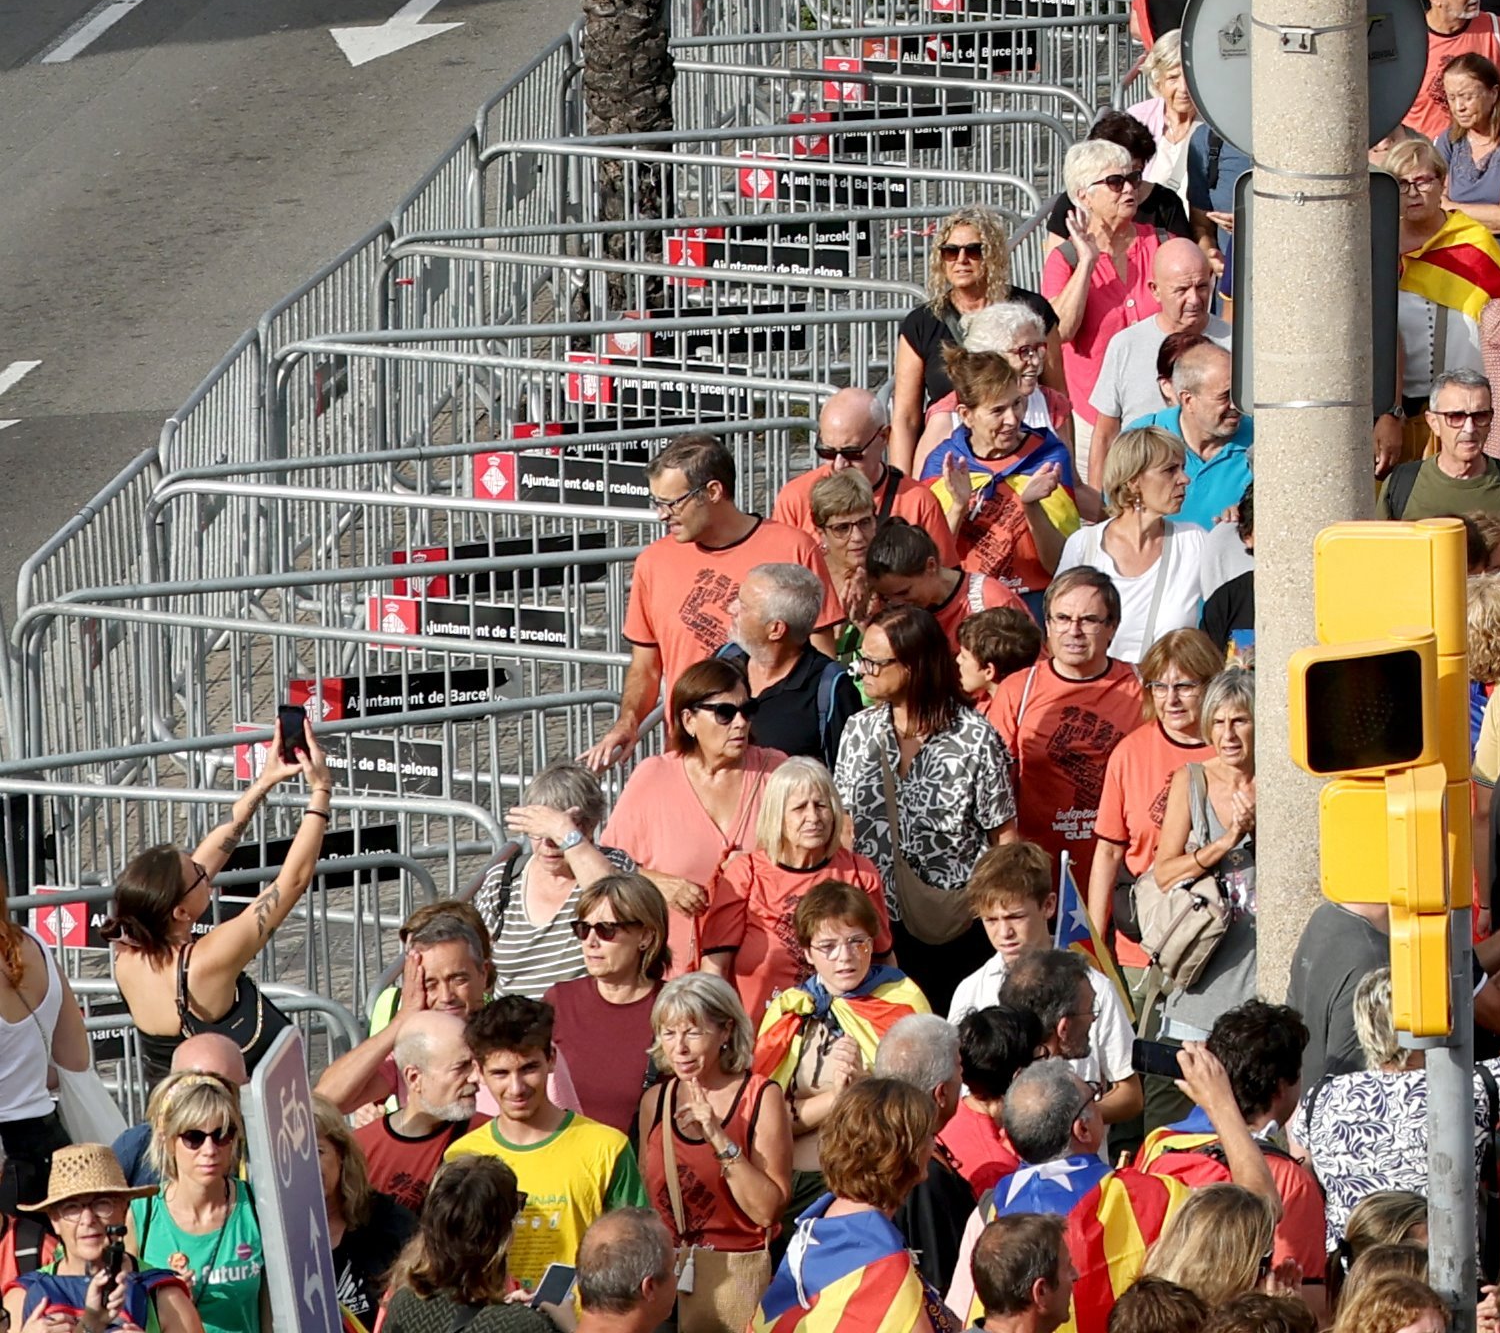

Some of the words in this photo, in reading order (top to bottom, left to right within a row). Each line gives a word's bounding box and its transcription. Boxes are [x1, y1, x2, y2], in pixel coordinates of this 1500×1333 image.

[982, 45, 1033, 59] Barceona
[855, 178, 905, 193] Bacelna
[814, 229, 867, 243] Barceloa
[791, 264, 843, 278] Barelona
[613, 377, 673, 393] Ajunamnt
[692, 382, 744, 398] Barcelna
[582, 480, 596, 491] de
[596, 481, 650, 497] Brcelona
[425, 620, 490, 638] juntamnt
[492, 626, 507, 638] de
[347, 693, 424, 711] Ajntamnt
[428, 693, 444, 705] de
[359, 757, 375, 771] de
